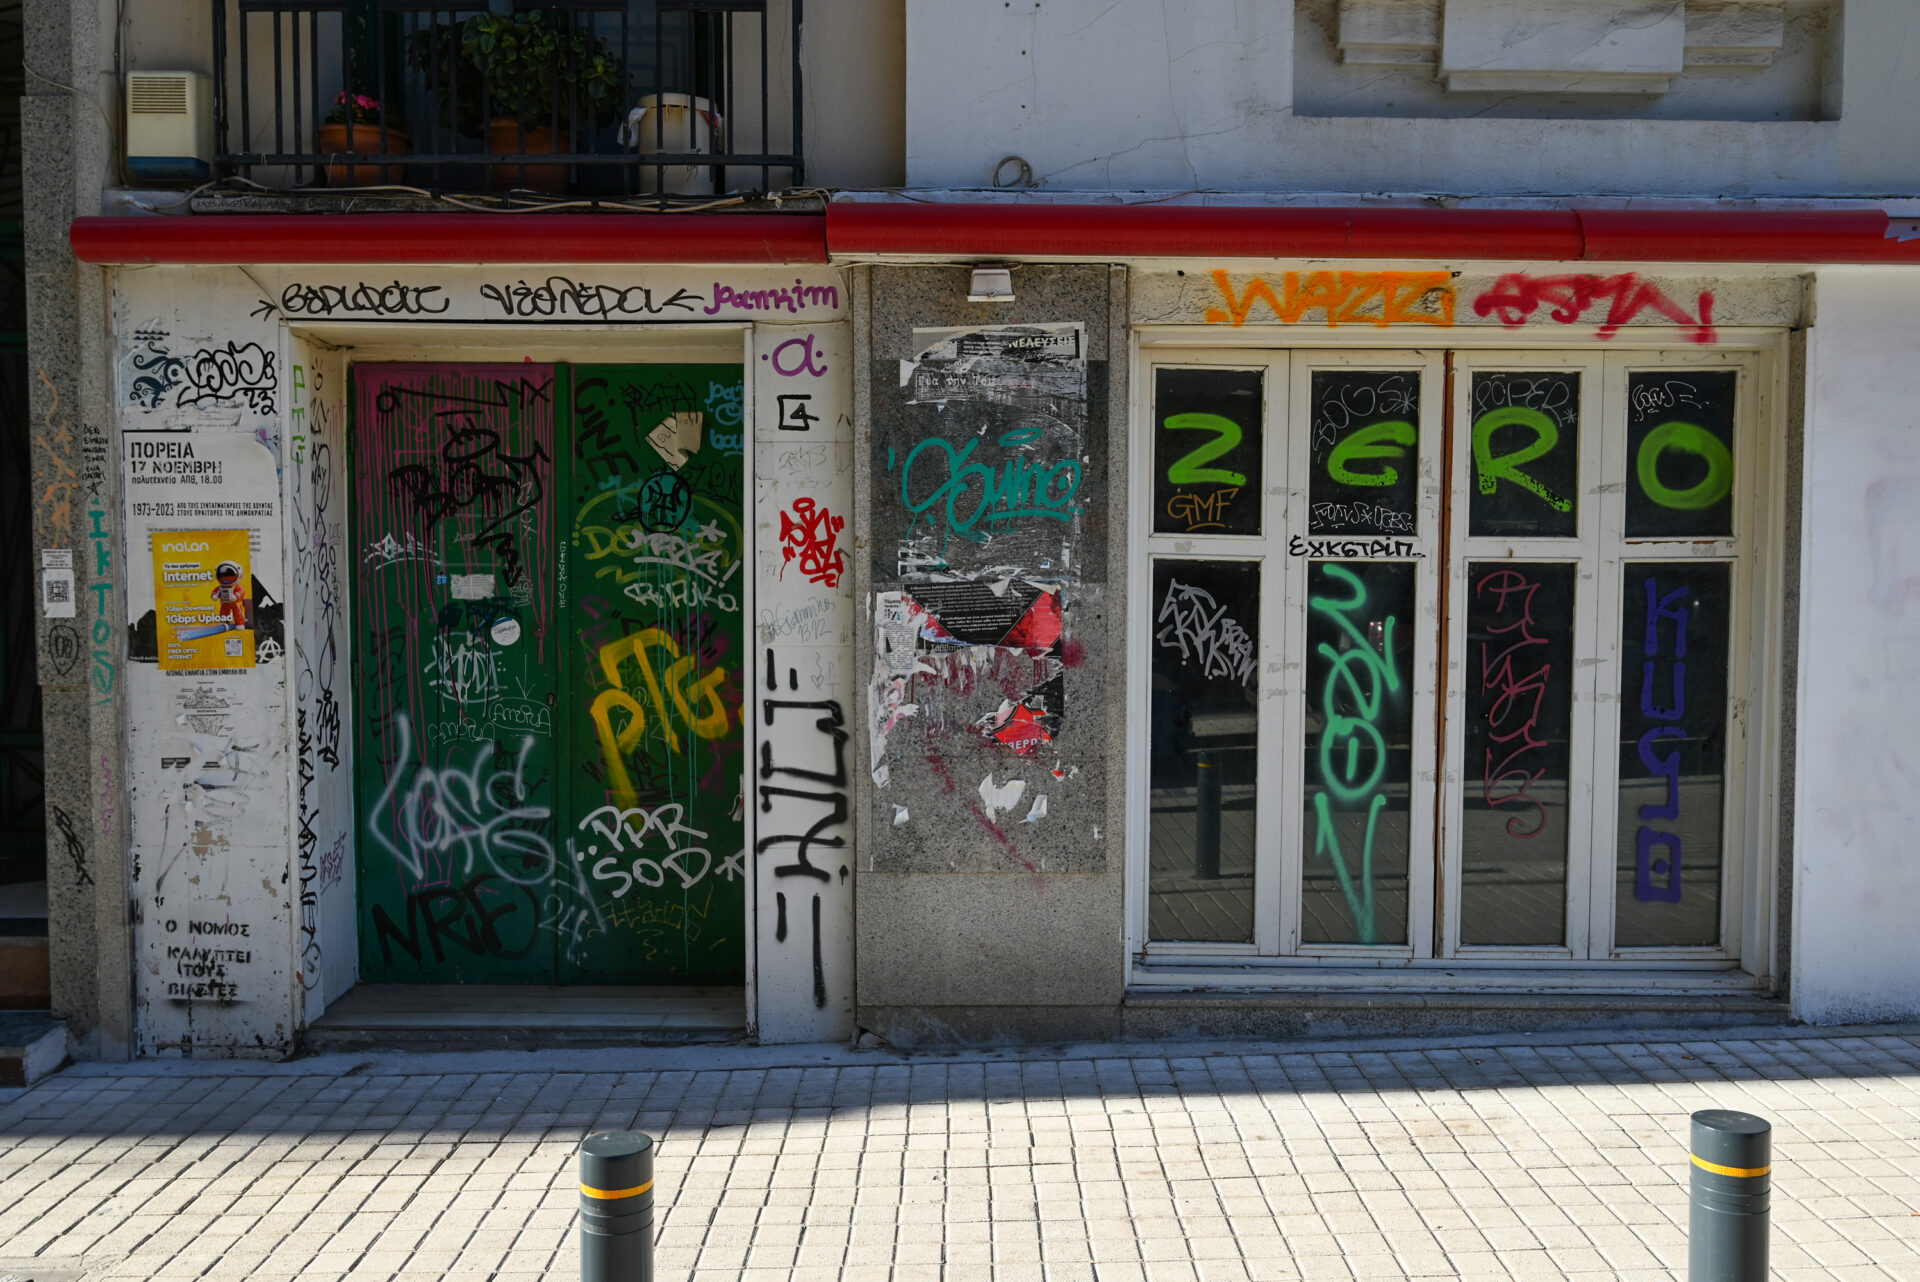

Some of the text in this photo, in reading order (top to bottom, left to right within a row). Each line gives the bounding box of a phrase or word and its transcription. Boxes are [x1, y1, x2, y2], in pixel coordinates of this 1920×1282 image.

[131, 442, 194, 458] ΠΟΡΕΙΑ
[131, 461, 222, 474] 17 ΝΟΕΜΒΡΗ
[132, 475, 176, 485] πολυτεχνείο
[201, 475, 222, 484] 18.00
[132, 503, 174, 517] 1973-2023
[164, 571, 213, 582] Internet
[166, 613, 234, 624] 1Gbps Upload
[165, 920, 250, 937] Ο ΝΟΜΟΣ
